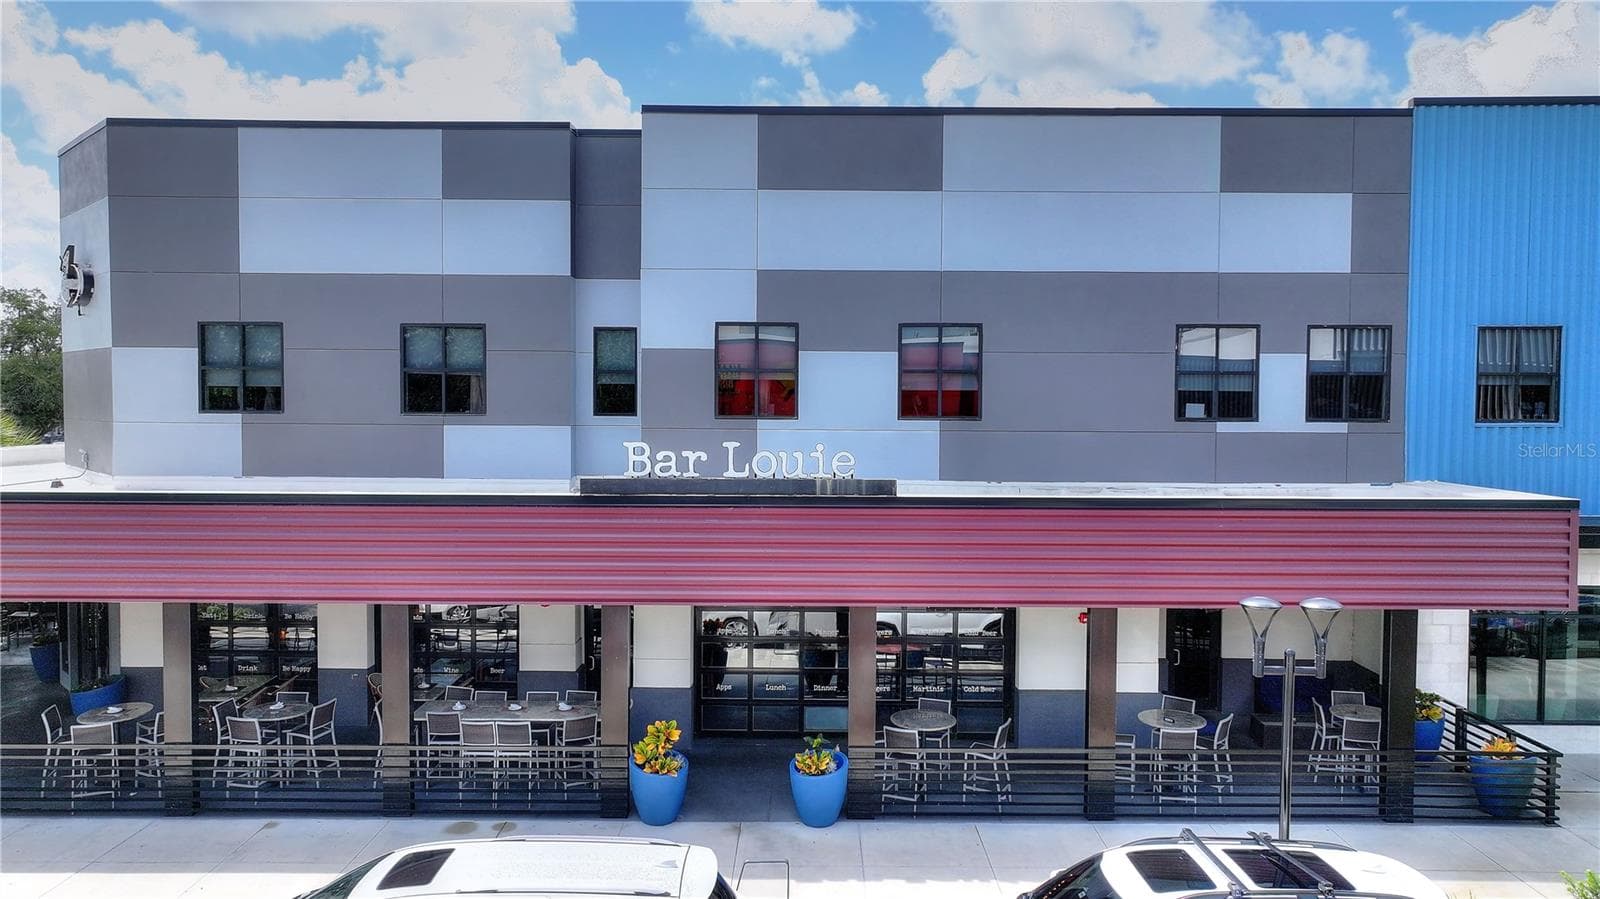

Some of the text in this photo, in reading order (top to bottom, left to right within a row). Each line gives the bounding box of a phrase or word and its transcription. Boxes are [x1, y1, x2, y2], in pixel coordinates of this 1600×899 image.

[622, 441, 857, 479] Bar Louie
[291, 665, 311, 673] Happy
[716, 683, 732, 691] Apps
[912, 685, 944, 693] Martinis
